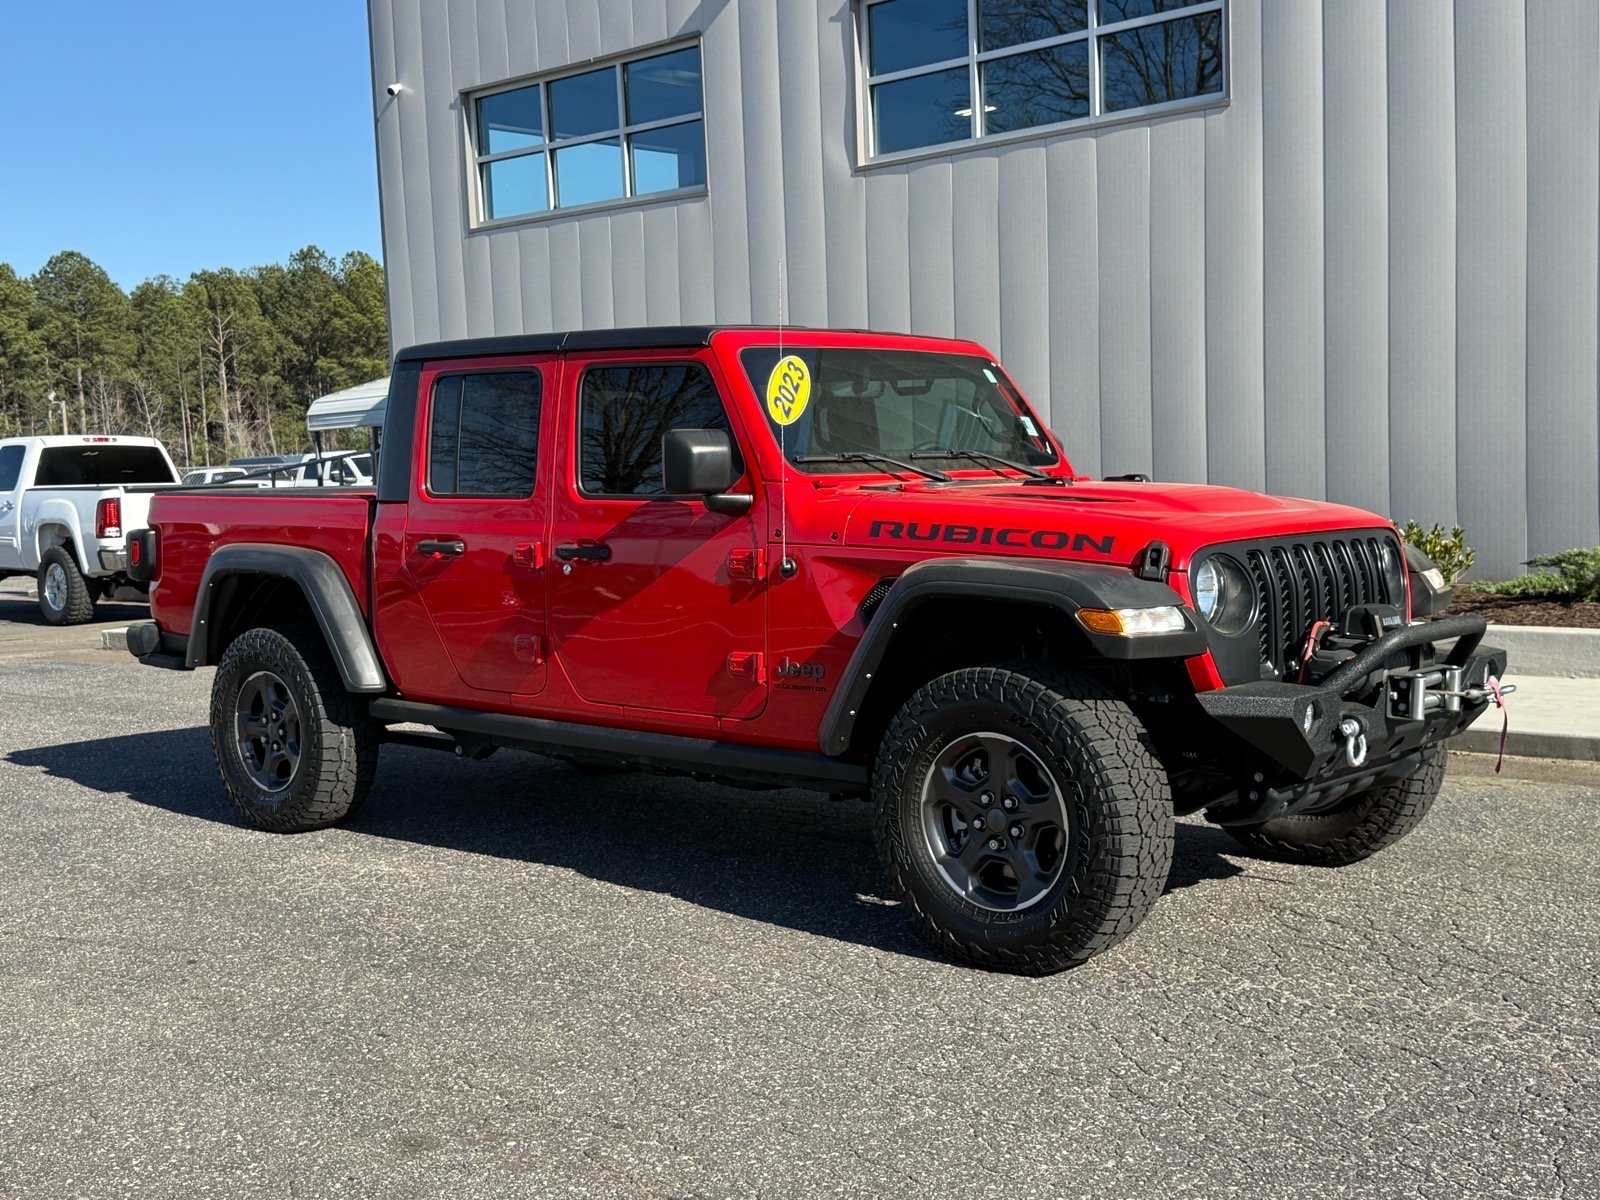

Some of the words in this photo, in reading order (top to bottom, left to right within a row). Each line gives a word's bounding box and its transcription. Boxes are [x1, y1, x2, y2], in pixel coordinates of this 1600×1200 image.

[773, 360, 805, 420] 2023
[869, 520, 1116, 553] RUBICON
[776, 656, 826, 684] Jeep
